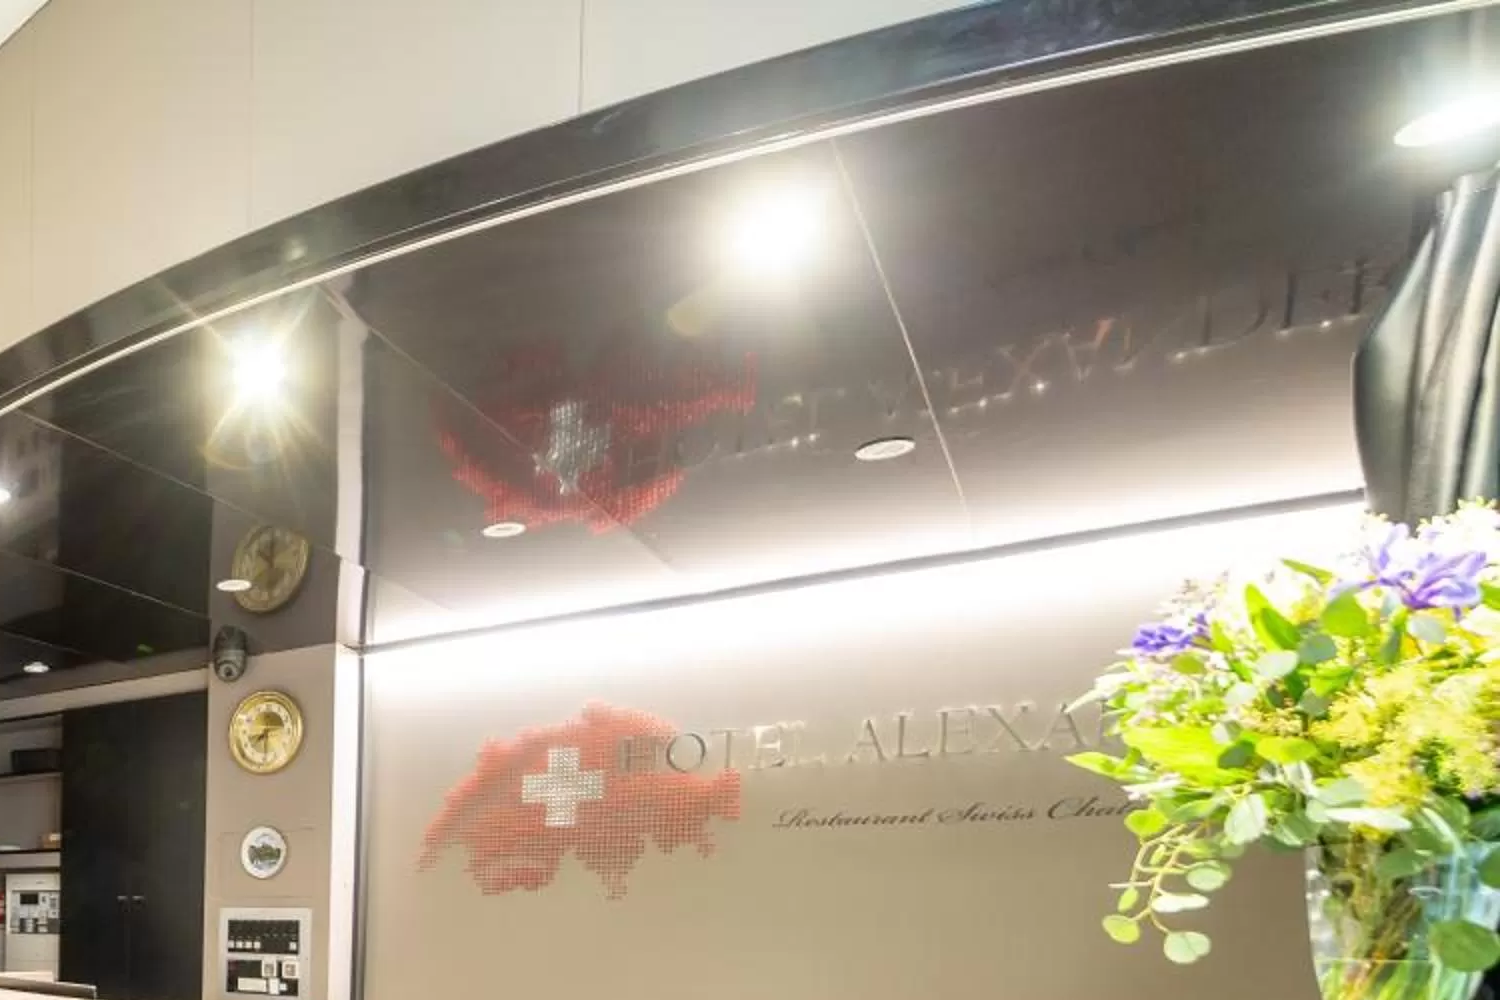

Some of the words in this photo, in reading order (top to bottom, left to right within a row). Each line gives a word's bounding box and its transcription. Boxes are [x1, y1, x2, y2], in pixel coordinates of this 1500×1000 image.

[617, 719, 827, 775] HOTEL
[772, 804, 935, 829] Restaurant
[936, 802, 1036, 823] Swiss
